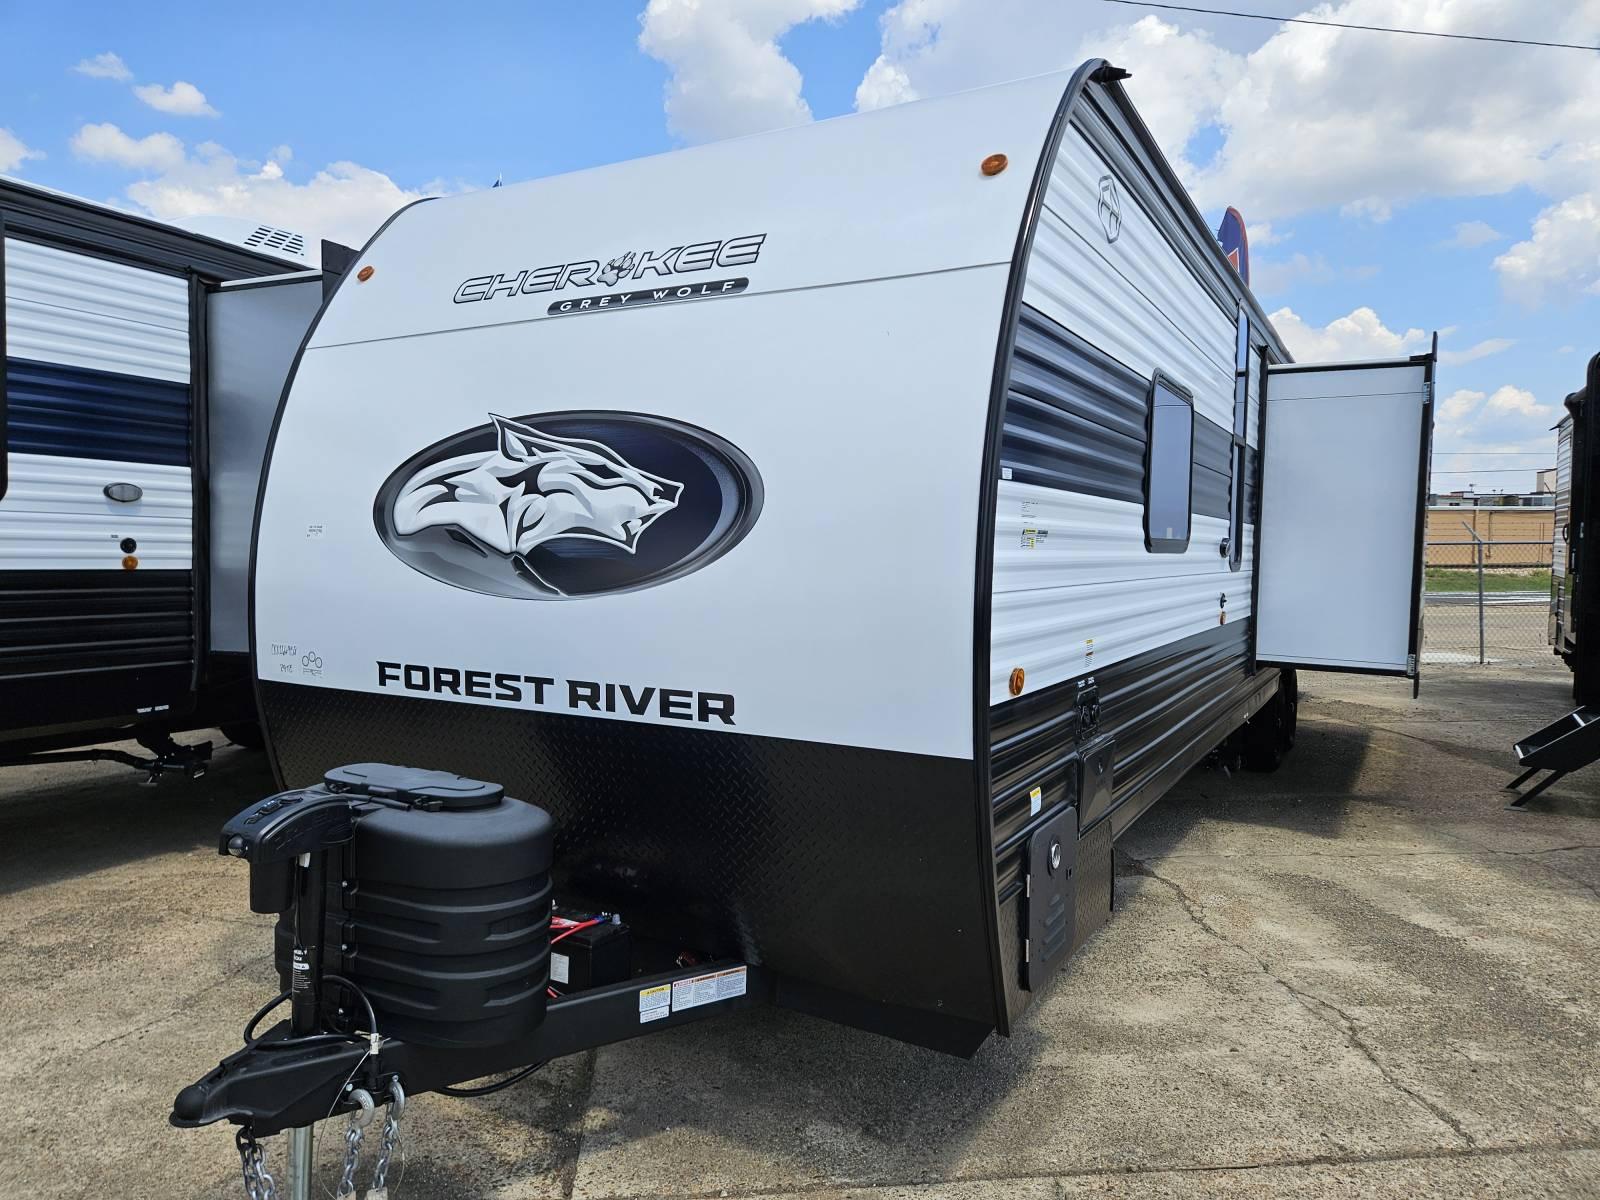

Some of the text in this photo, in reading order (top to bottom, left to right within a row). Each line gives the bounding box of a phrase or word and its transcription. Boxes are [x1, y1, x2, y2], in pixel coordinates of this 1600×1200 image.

[559, 281, 736, 312] GREY WOLF
[376, 660, 736, 726] FOREST RIVER
